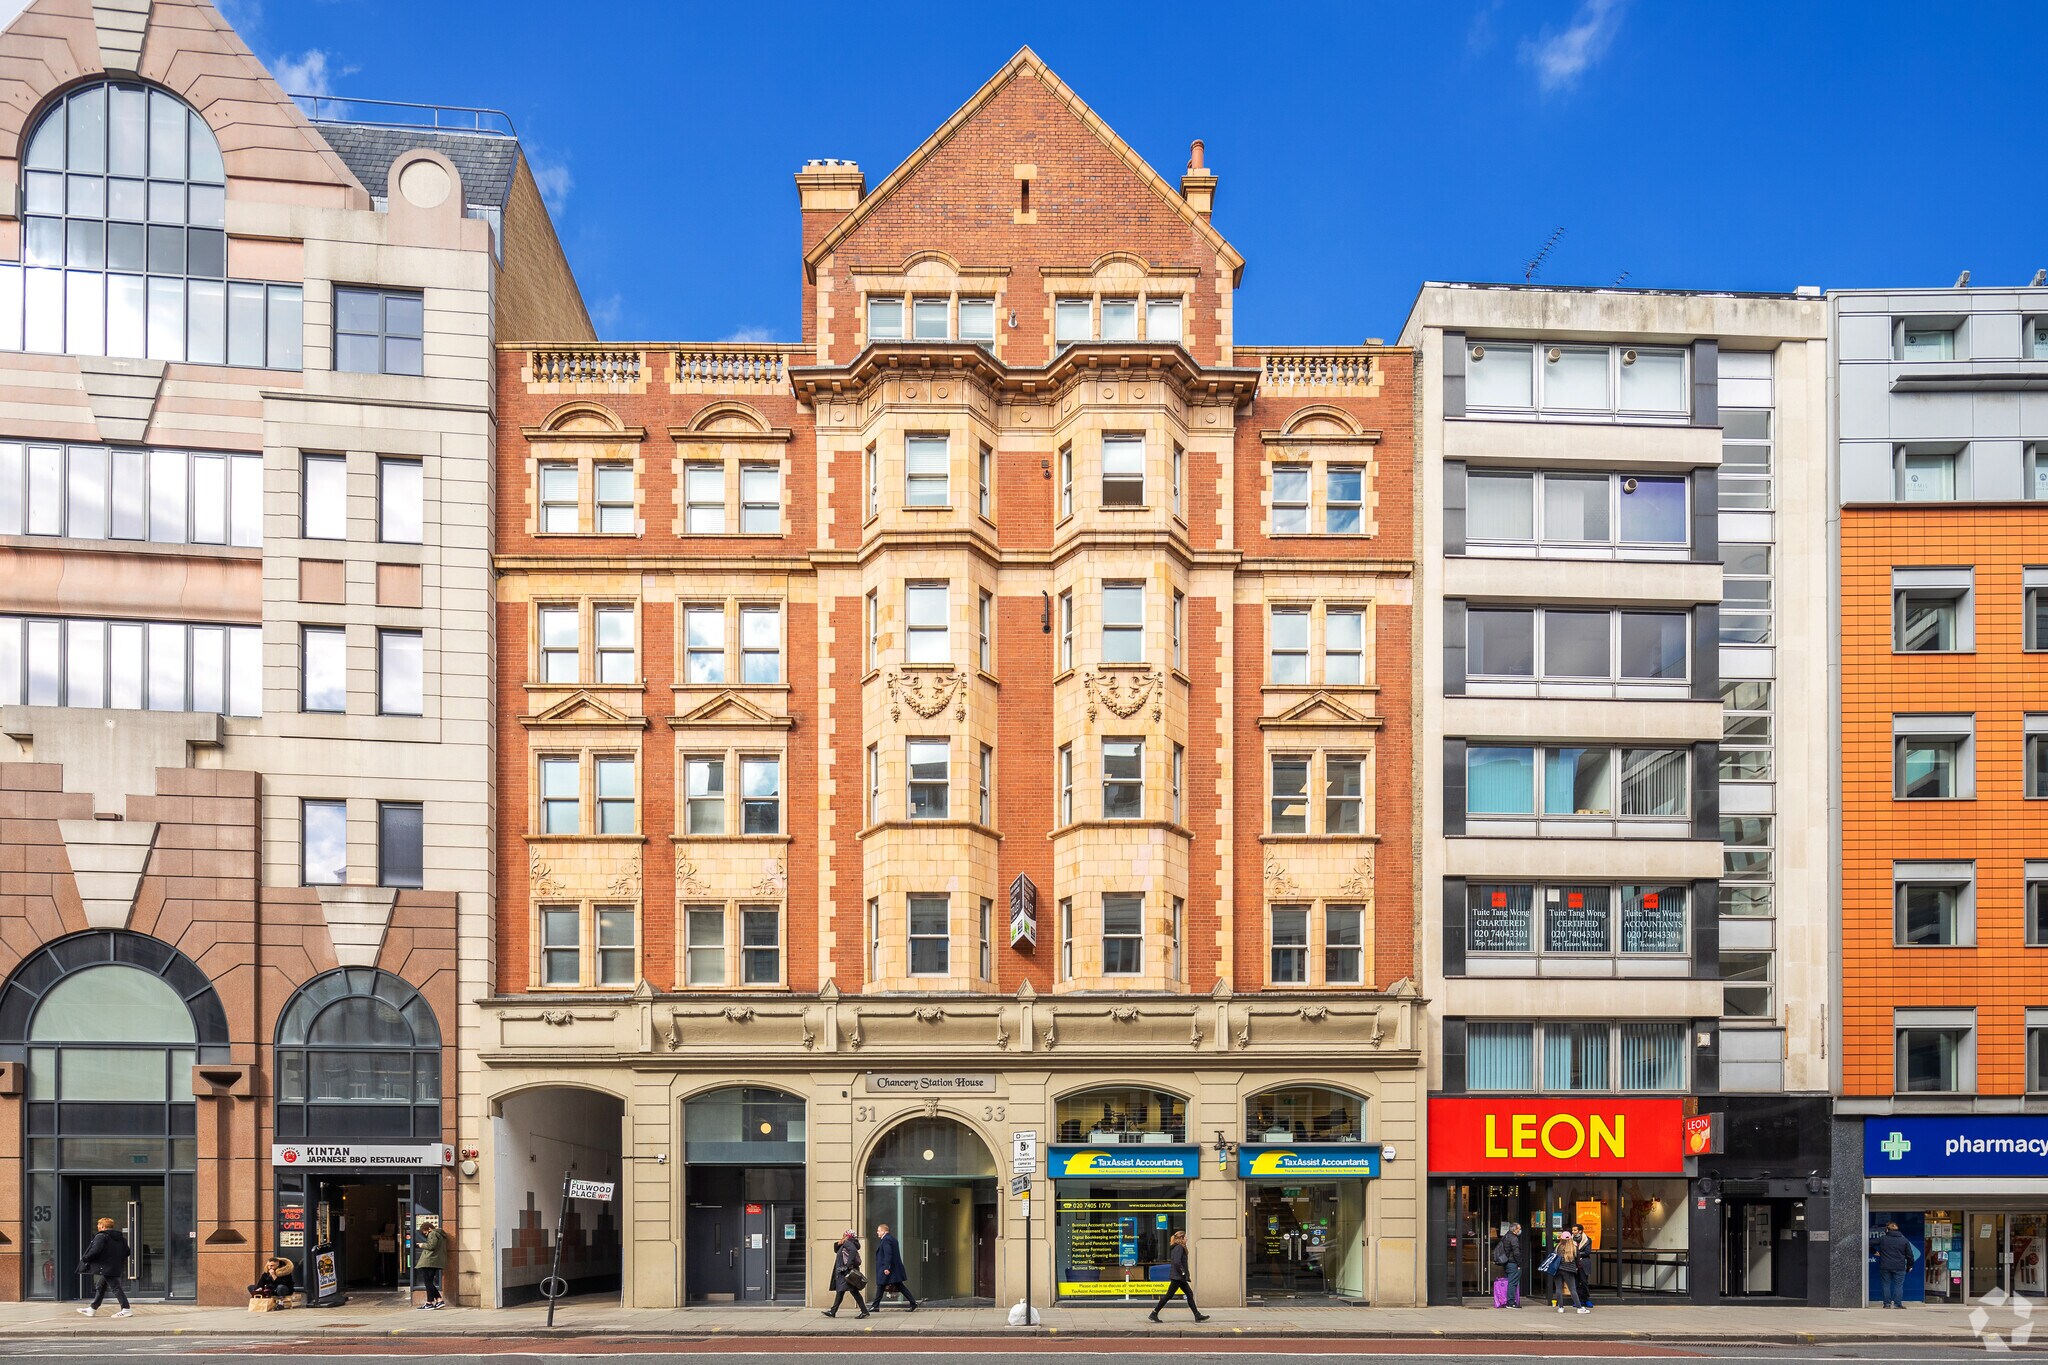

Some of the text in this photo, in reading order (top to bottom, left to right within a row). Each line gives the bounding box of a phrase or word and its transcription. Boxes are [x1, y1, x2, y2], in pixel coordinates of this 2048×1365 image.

[1492, 908, 1508, 918] Tang
[1510, 908, 1530, 918] Wong
[1568, 909, 1585, 918] Tang
[1586, 909, 1606, 918] Wong
[1644, 910, 1661, 918] Tang
[1662, 910, 1681, 918] Wong
[1475, 940, 1486, 948] Top
[877, 1078, 984, 1090] Chancery Station House
[856, 1106, 877, 1122] 31
[982, 1106, 1006, 1122] 33
[1687, 1118, 1708, 1130] LEON
[1485, 1113, 1625, 1159] LEON
[1946, 1135, 2048, 1157] pharmacy
[306, 1148, 350, 1156] KINTAN
[571, 1190, 596, 1198] PLACE
[572, 1184, 611, 1193] FULWOOD
[34, 1206, 52, 1222] 35
